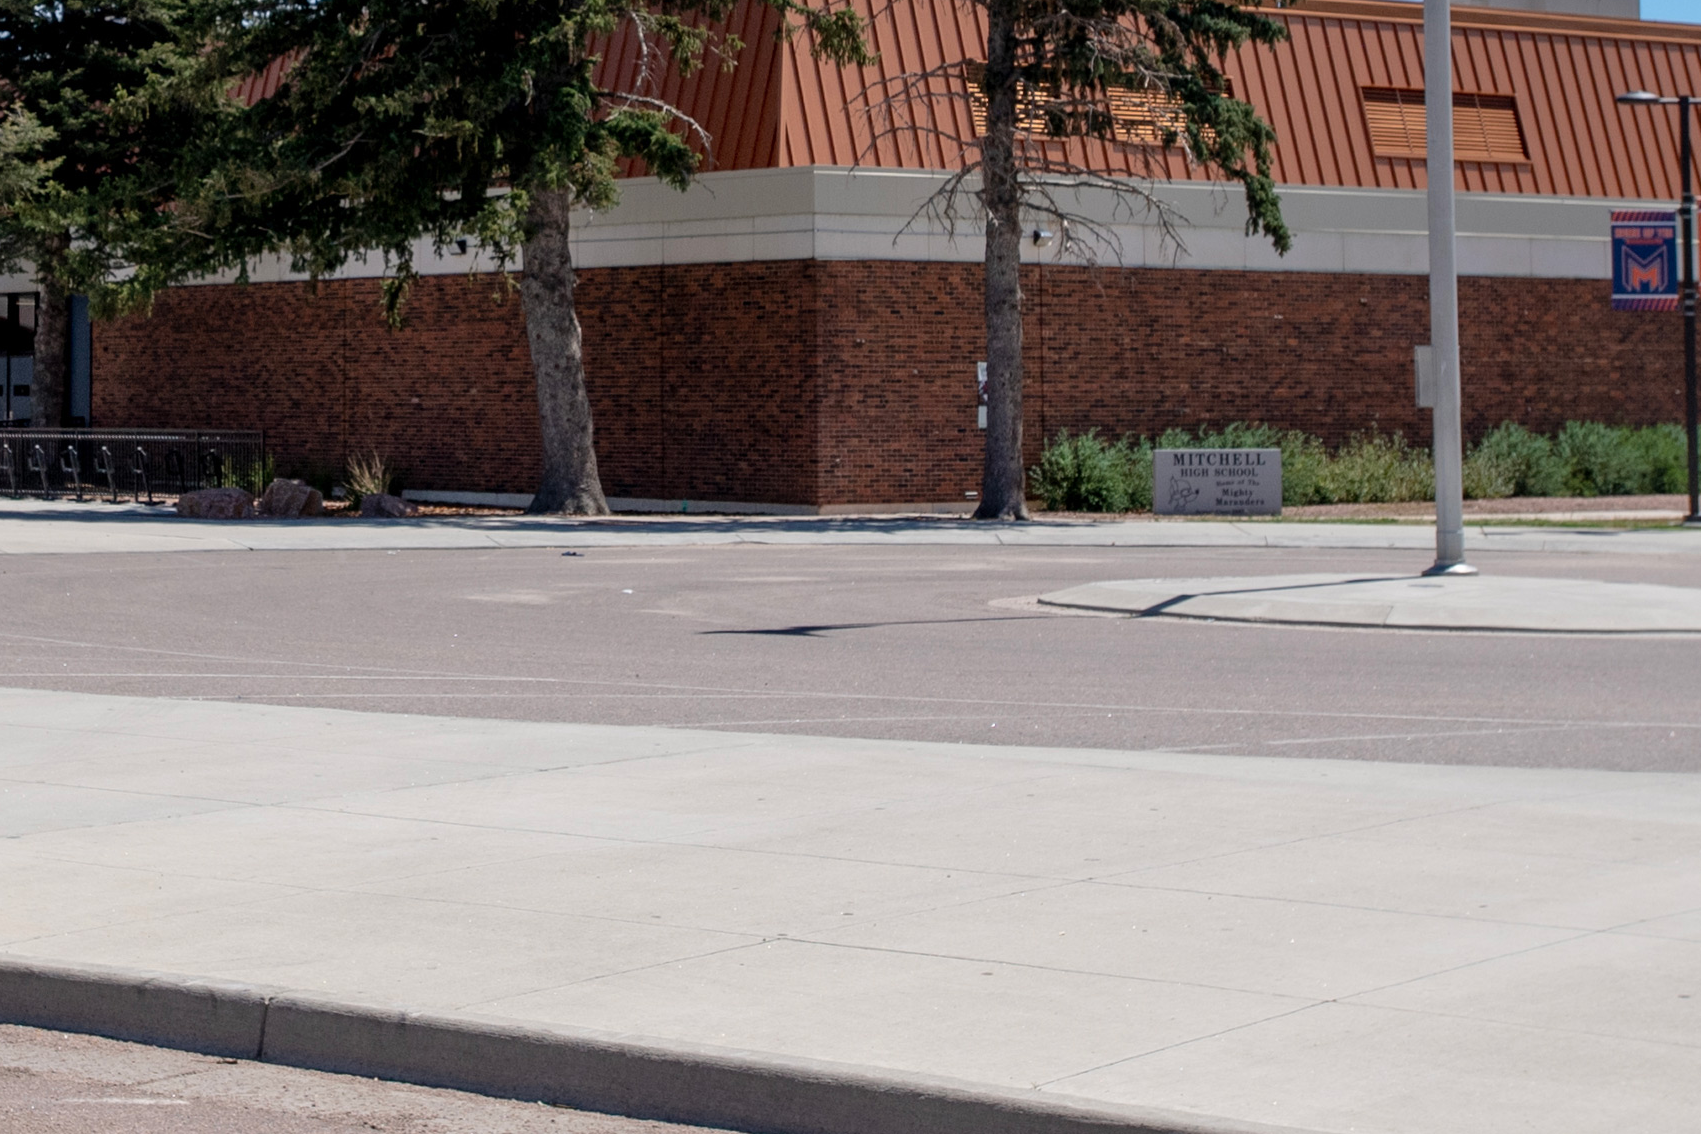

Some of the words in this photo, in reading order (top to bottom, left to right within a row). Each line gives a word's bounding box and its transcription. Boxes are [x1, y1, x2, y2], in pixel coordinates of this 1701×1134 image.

[1173, 453, 1266, 466] MITCHELL
[1180, 468, 1209, 478] HIGH
[1214, 468, 1259, 478] SCHOOL
[1222, 488, 1253, 498] Mighty
[1216, 497, 1265, 506] Marauders
